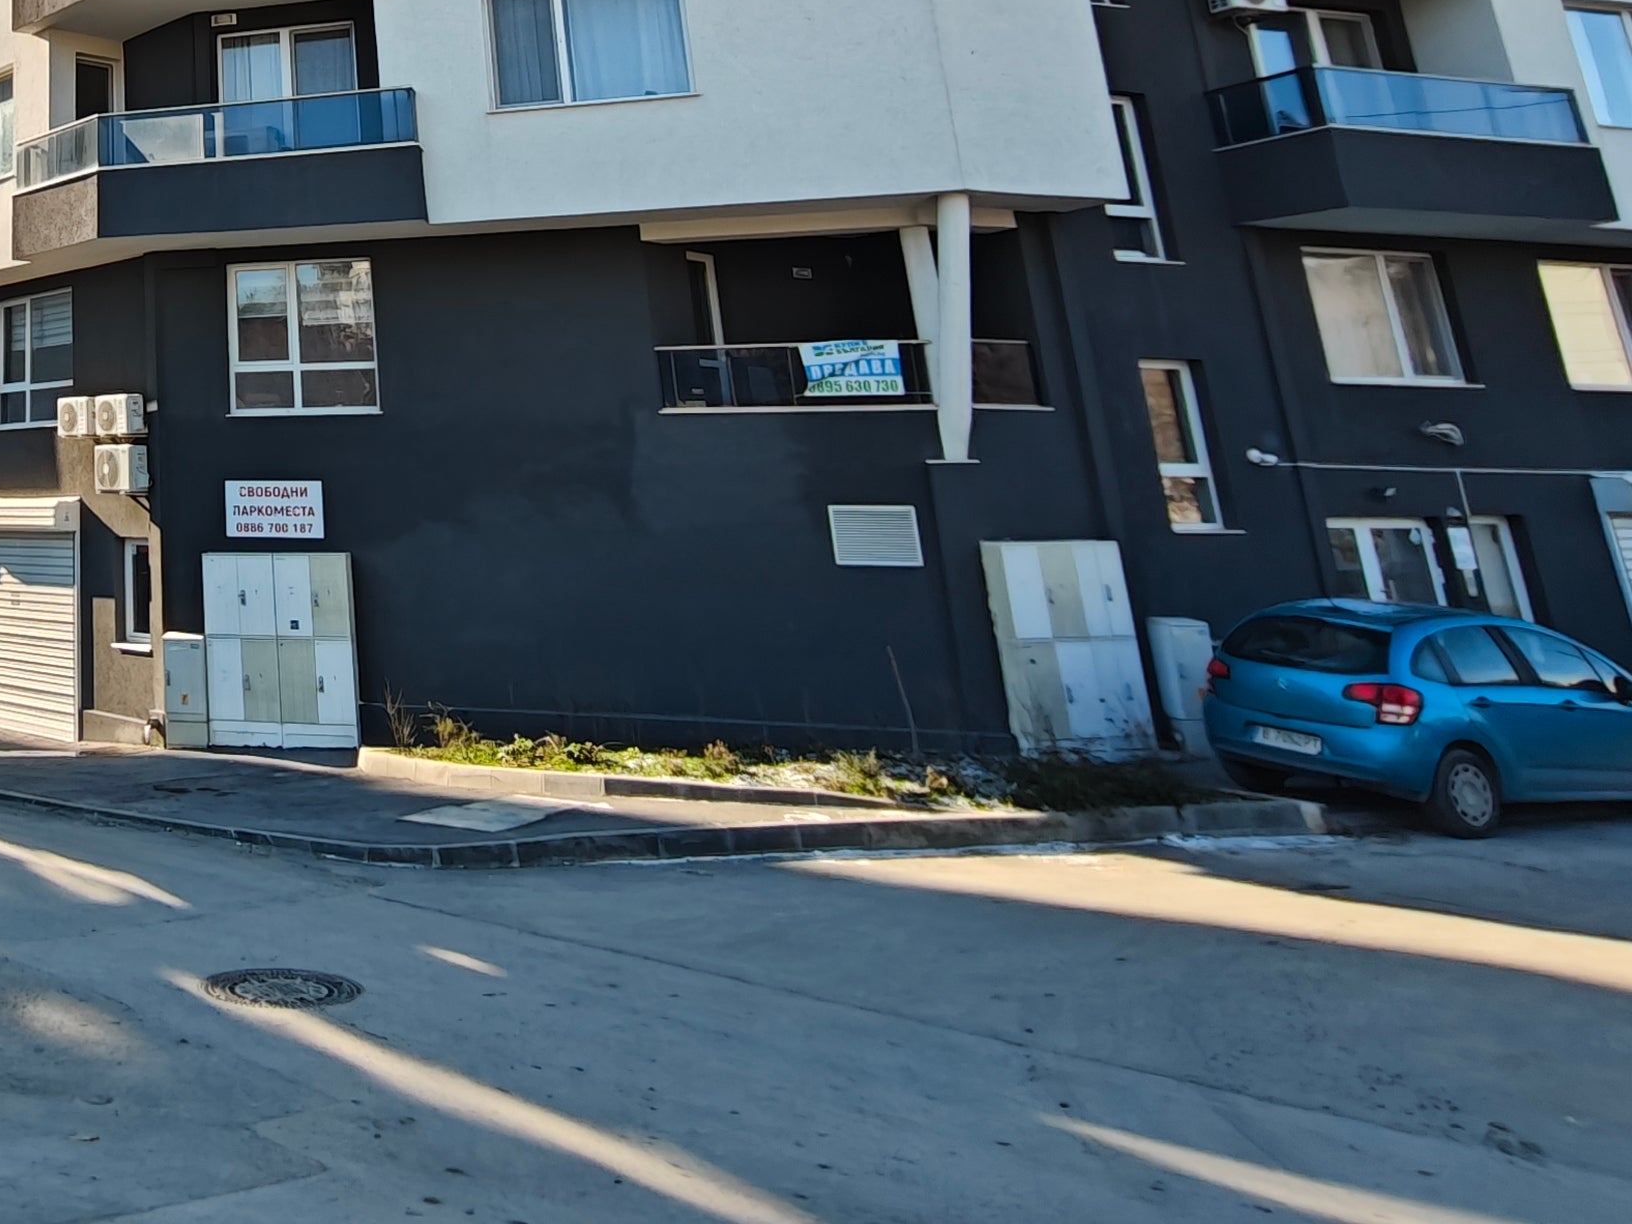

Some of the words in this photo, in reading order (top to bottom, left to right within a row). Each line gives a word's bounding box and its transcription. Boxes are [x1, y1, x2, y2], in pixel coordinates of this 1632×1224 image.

[845, 379, 872, 393] 630
[873, 379, 899, 392] 730
[239, 486, 308, 499] СВОБОДНИ
[232, 504, 316, 517] ПАРКОМЕСТА
[236, 522, 264, 533] 0886
[268, 523, 289, 533] 700
[292, 523, 314, 534] 187
